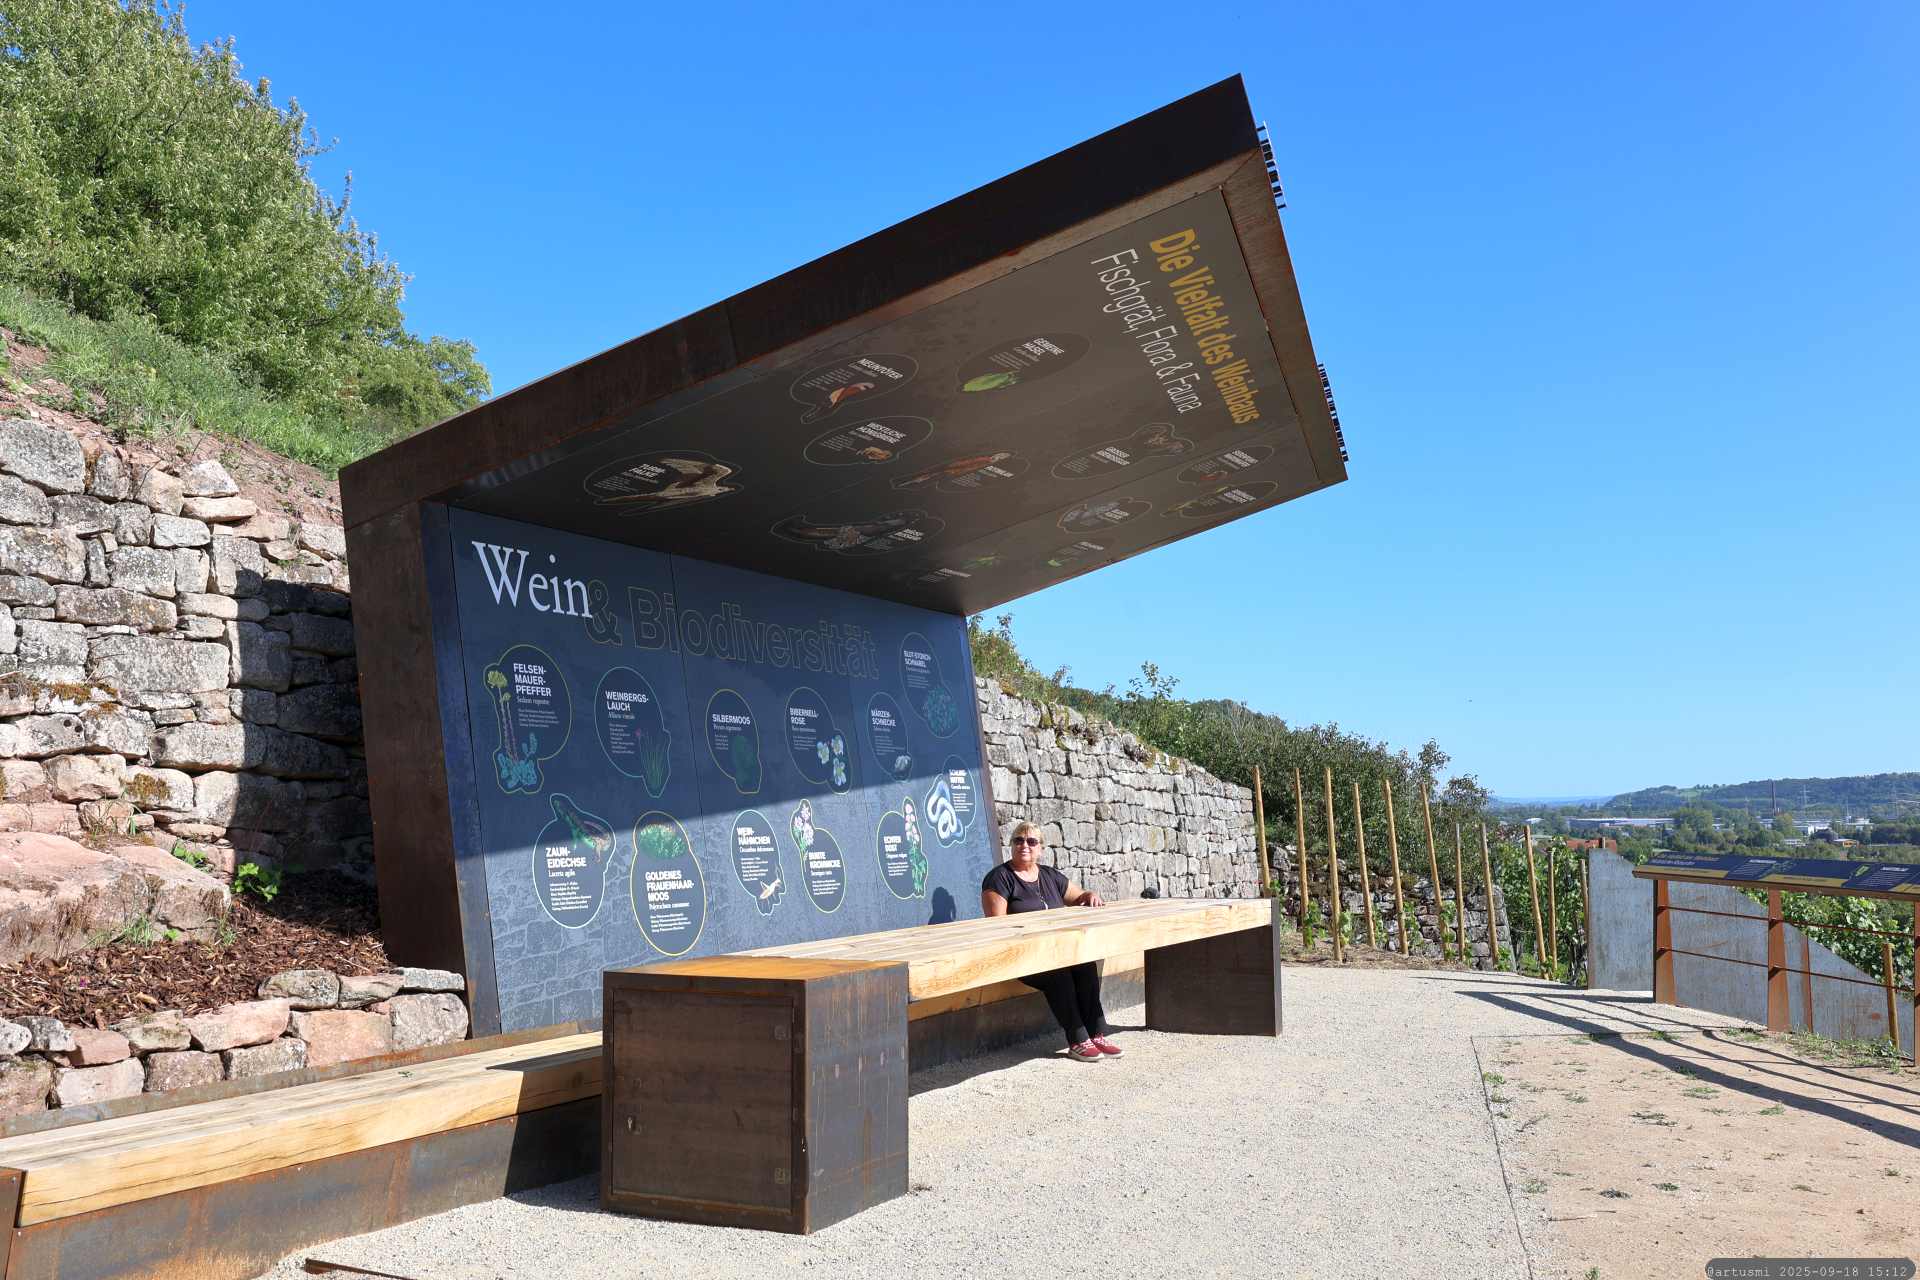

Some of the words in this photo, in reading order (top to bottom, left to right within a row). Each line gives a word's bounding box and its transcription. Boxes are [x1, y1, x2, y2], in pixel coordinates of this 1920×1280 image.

[1150, 228, 1200, 272] Die
[1090, 248, 1167, 334] Fischgrät,
[1168, 265, 1230, 337] Vielfalt
[1136, 324, 1179, 367] Flora
[1197, 332, 1237, 366] des
[1156, 362, 1194, 380] &
[1162, 372, 1202, 414] Fauna
[1211, 358, 1260, 424] Weinbaus
[472, 540, 593, 618] Wein
[584, 579, 624, 647] &
[627, 586, 881, 680] Biodiversität
[513, 663, 547, 674] FELSEN-
[514, 674, 546, 686] MAUER-
[516, 685, 552, 696] PFEFFER
[605, 690, 648, 702] WEINBERGS-
[607, 701, 630, 711] LAUCH
[712, 714, 750, 725] SILBERMOOS
[546, 847, 570, 857] ZAUN-
[547, 857, 587, 868] EIDECHSE
[645, 870, 682, 880] GOLDENES
[648, 892, 669, 902] MOOS
